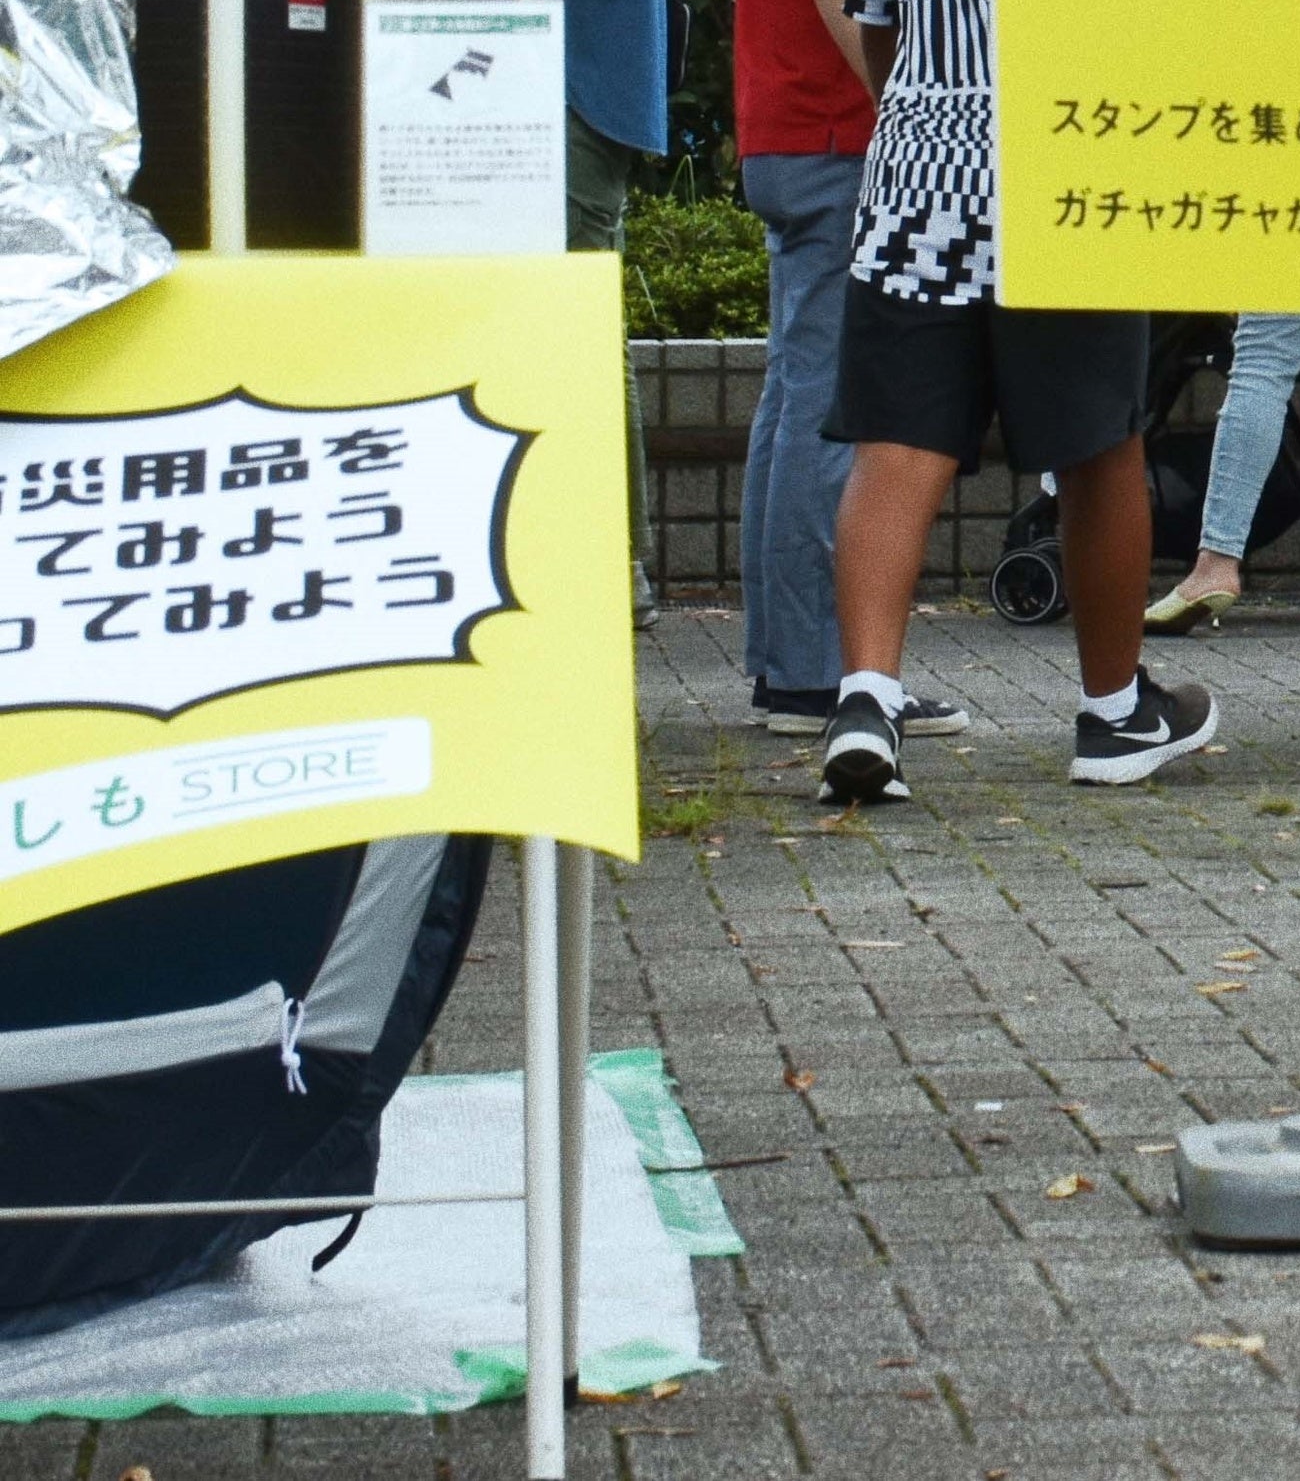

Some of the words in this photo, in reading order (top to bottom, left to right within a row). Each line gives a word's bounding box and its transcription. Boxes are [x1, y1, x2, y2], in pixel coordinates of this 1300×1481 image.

[0, 428, 408, 512] 災用品を
[15, 490, 404, 577] てみよう
[180, 745, 380, 803] STORE
